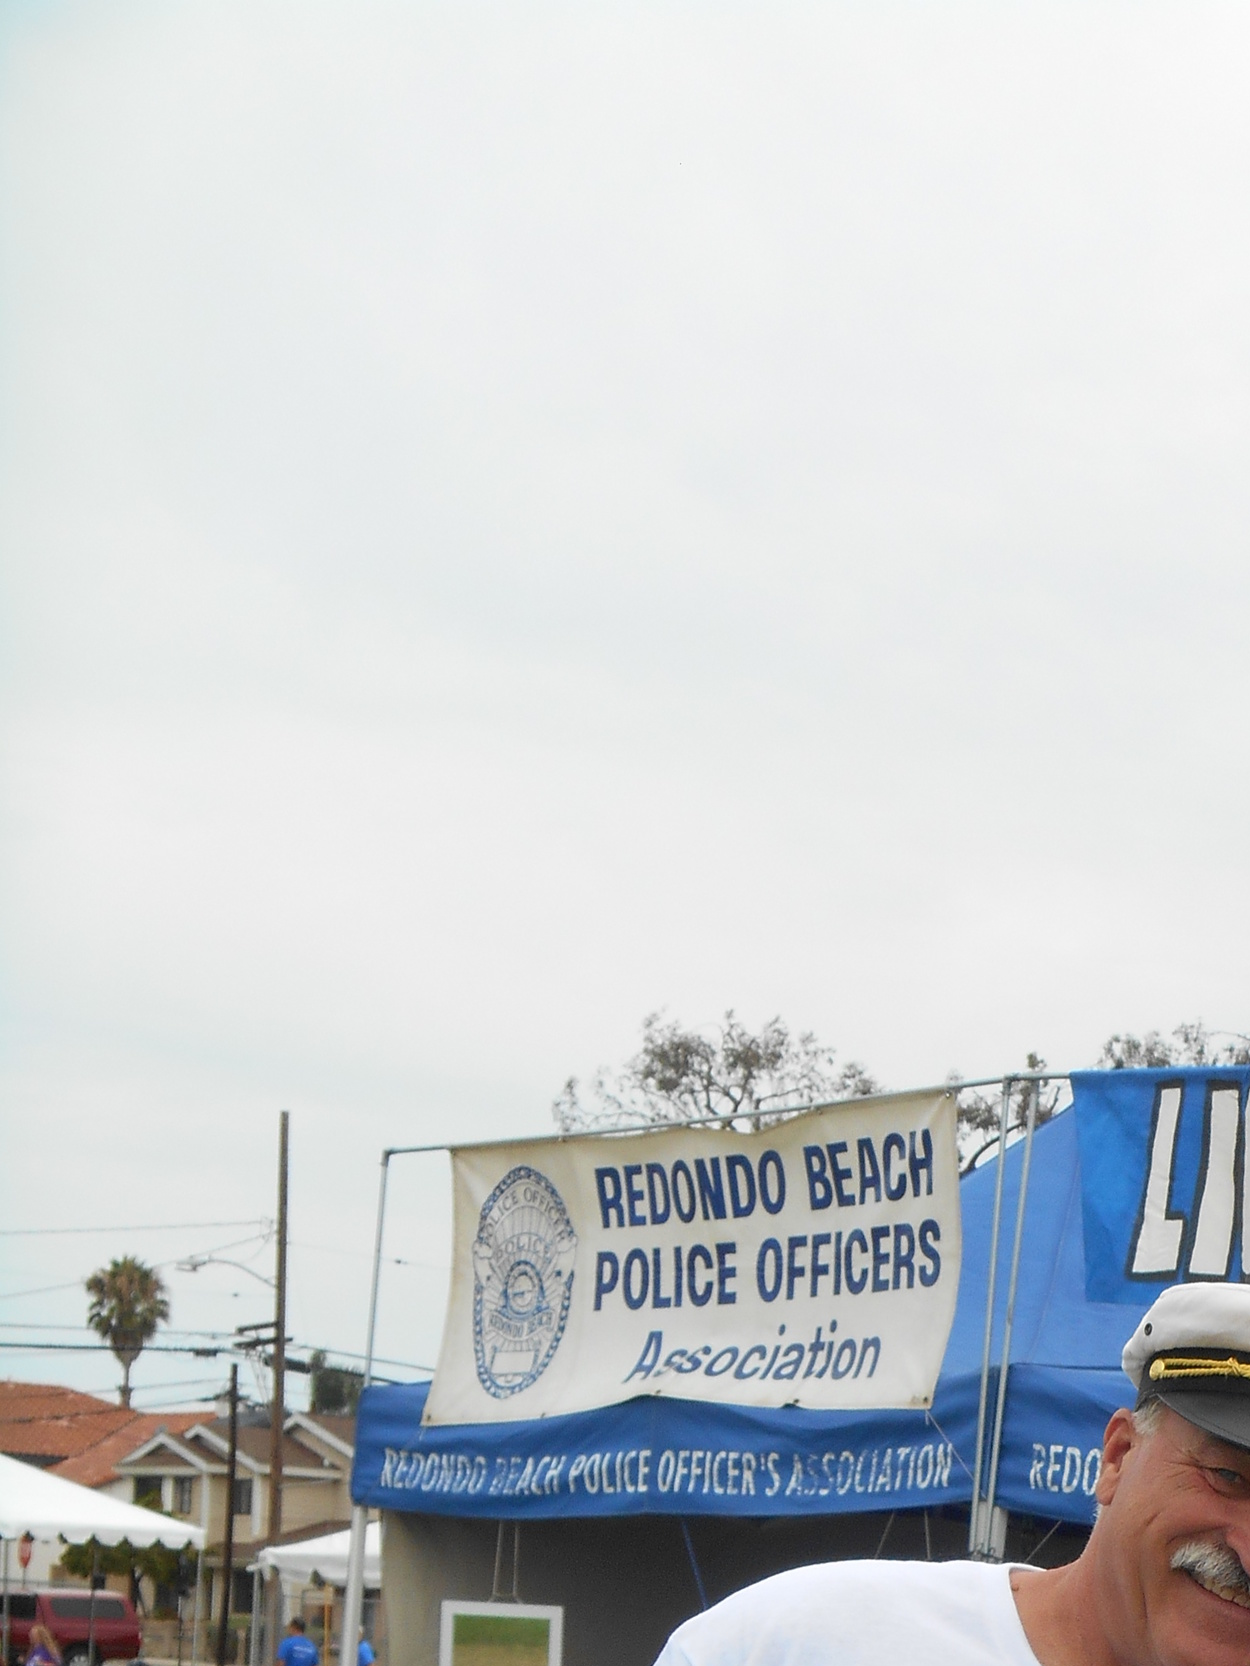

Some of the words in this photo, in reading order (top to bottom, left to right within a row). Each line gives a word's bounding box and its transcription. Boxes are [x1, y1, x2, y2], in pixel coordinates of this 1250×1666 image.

[594, 1149, 787, 1229] REDONDO
[802, 1128, 935, 1212] BEACH
[593, 1241, 738, 1312] POLICE
[756, 1218, 942, 1303] OFFICERS
[621, 1318, 882, 1384] Association
[381, 1446, 487, 1495] REDONDO
[488, 1453, 567, 1496] BEACH
[568, 1449, 652, 1494] POLICE
[657, 1449, 782, 1496] OFFICER'S
[785, 1442, 952, 1496] ASSOCIATION
[1029, 1443, 1102, 1496] REDO
